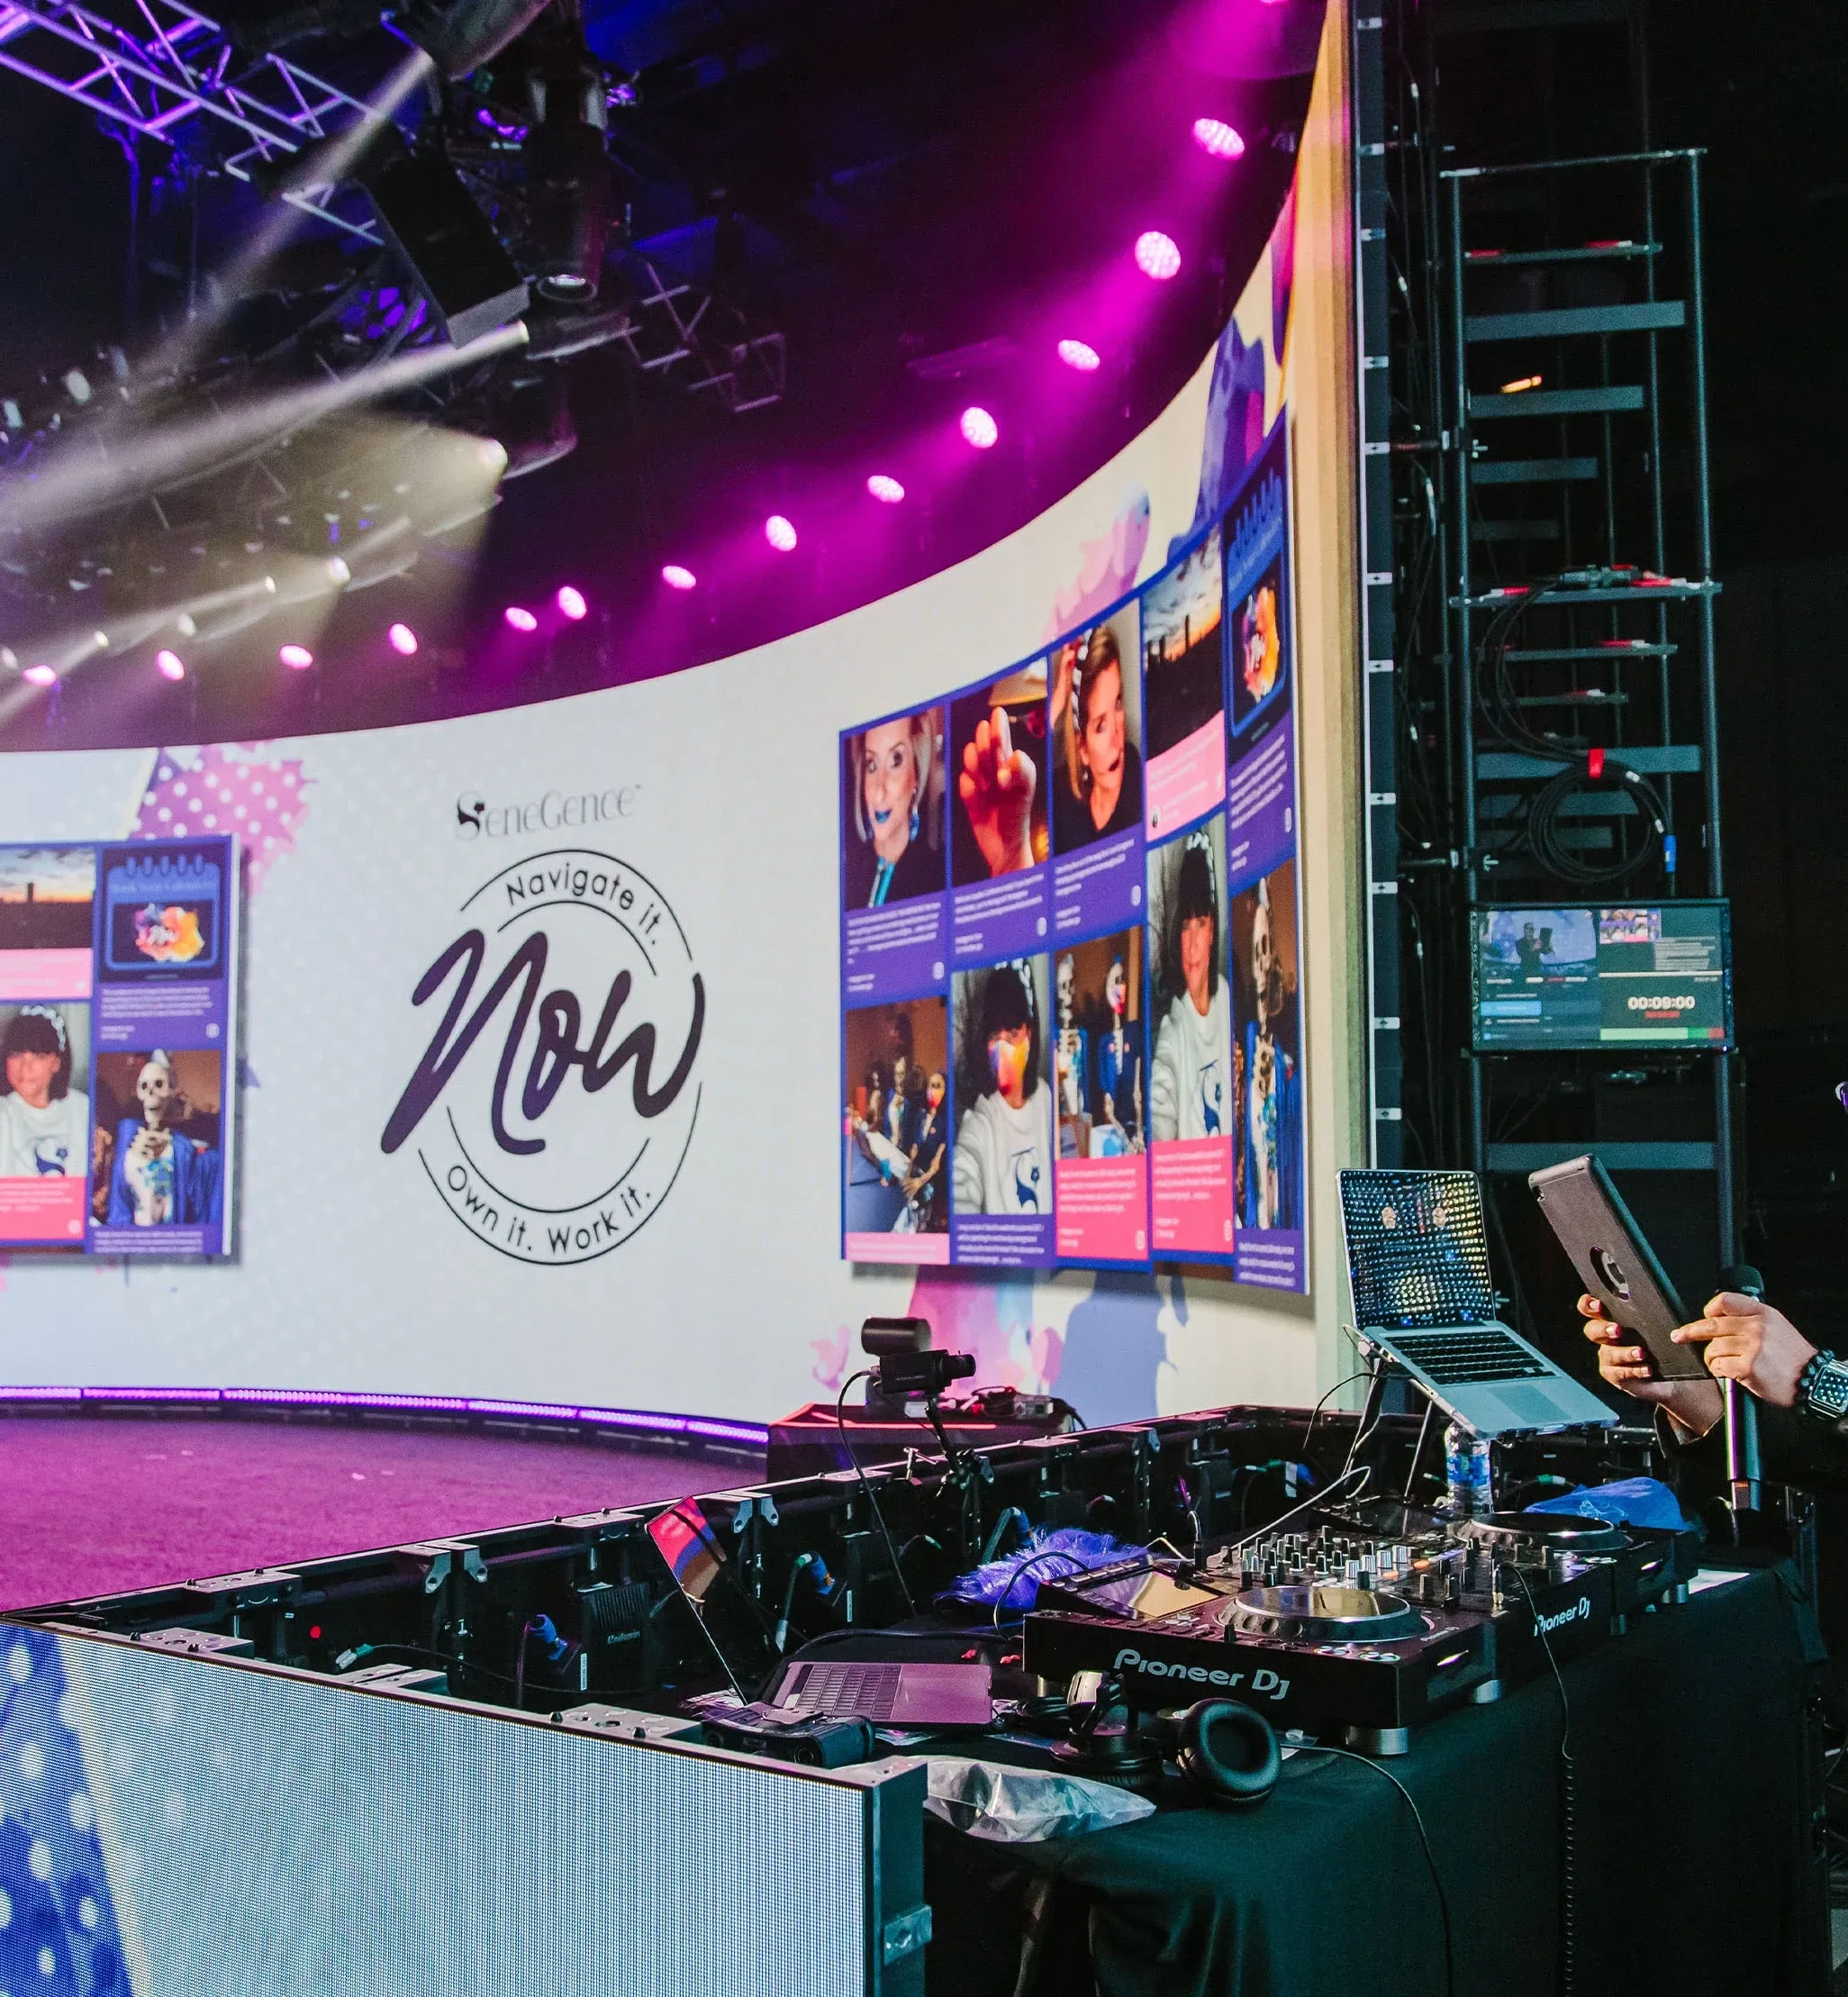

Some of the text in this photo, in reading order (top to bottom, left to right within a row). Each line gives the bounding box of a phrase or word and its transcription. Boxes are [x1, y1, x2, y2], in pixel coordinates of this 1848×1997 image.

[455, 785, 634, 841] SeneGence
[506, 862, 661, 945] Navigate it.
[380, 929, 706, 1155] Now
[448, 1165, 651, 1255] Own it. Work it.
[1112, 1648, 1246, 1686] Pioneer
